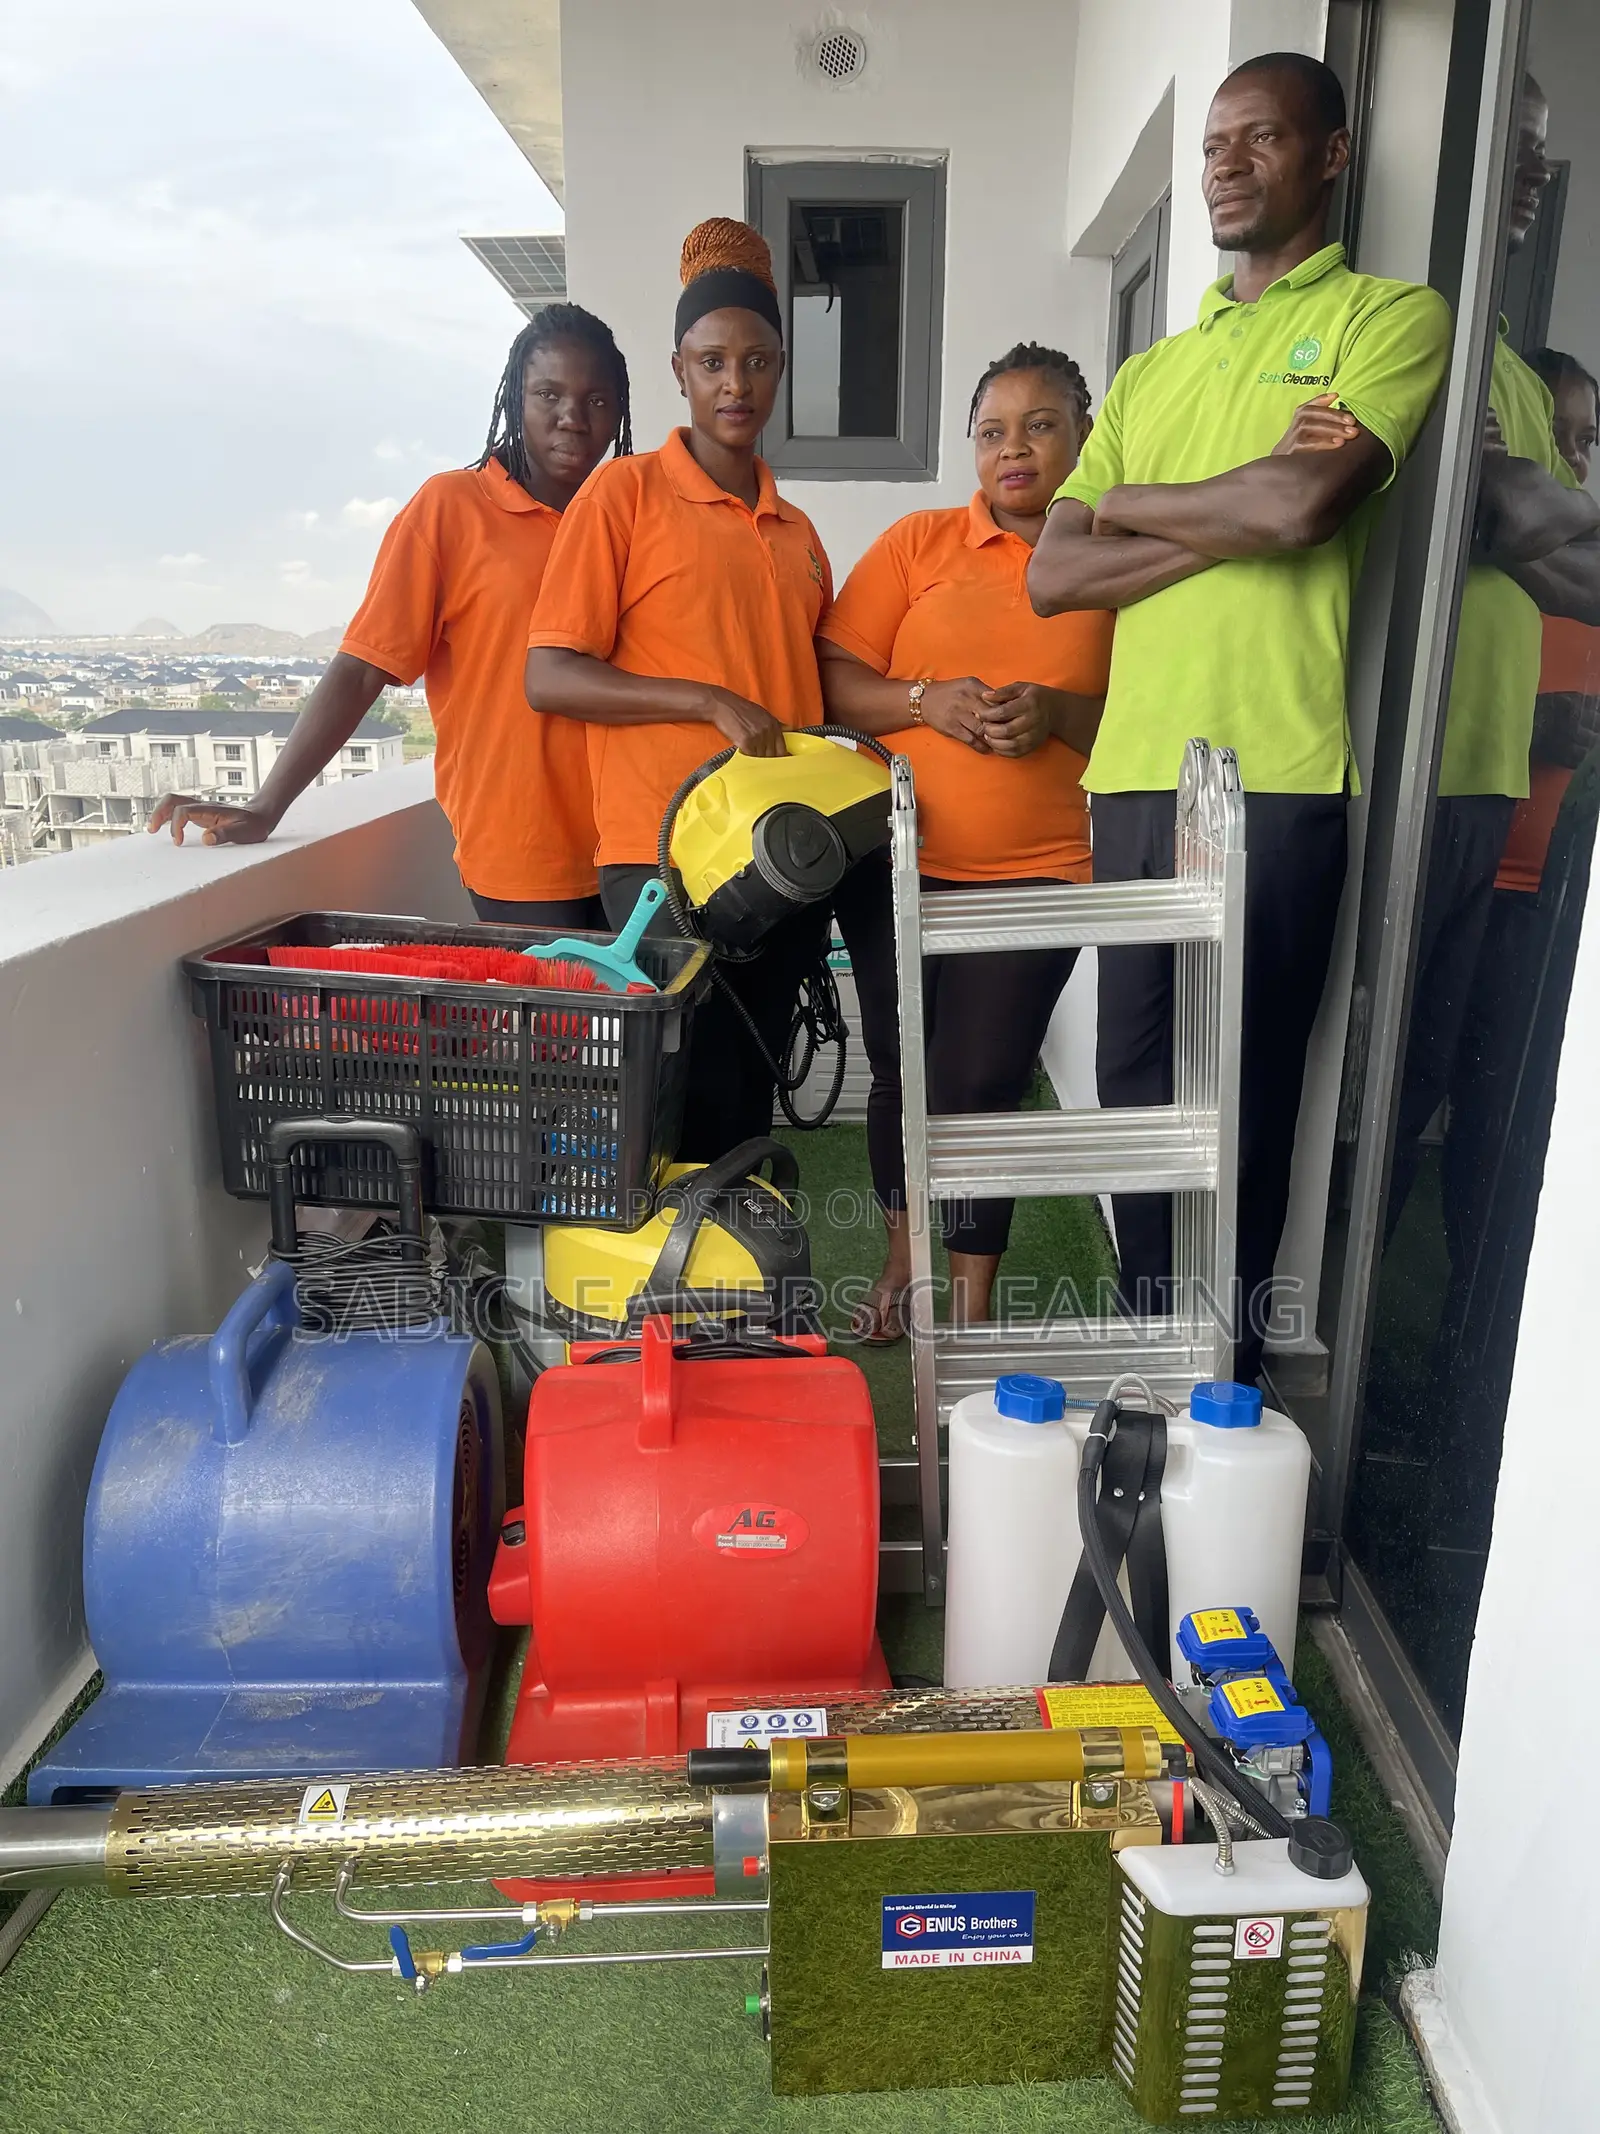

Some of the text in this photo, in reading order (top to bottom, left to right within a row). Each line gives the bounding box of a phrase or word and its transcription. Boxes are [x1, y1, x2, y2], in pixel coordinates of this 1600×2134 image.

[1294, 349, 1315, 361] SC
[726, 1508, 777, 1533] AG
[1220, 1612, 1229, 1622] key
[1253, 1681, 1265, 1692] key
[900, 1915, 1018, 1935] GENIUS Brothers
[962, 1933, 986, 1941] Enjoy
[1009, 1931, 1031, 1939] work
[895, 1950, 1022, 1965] MADE IN CHINA
